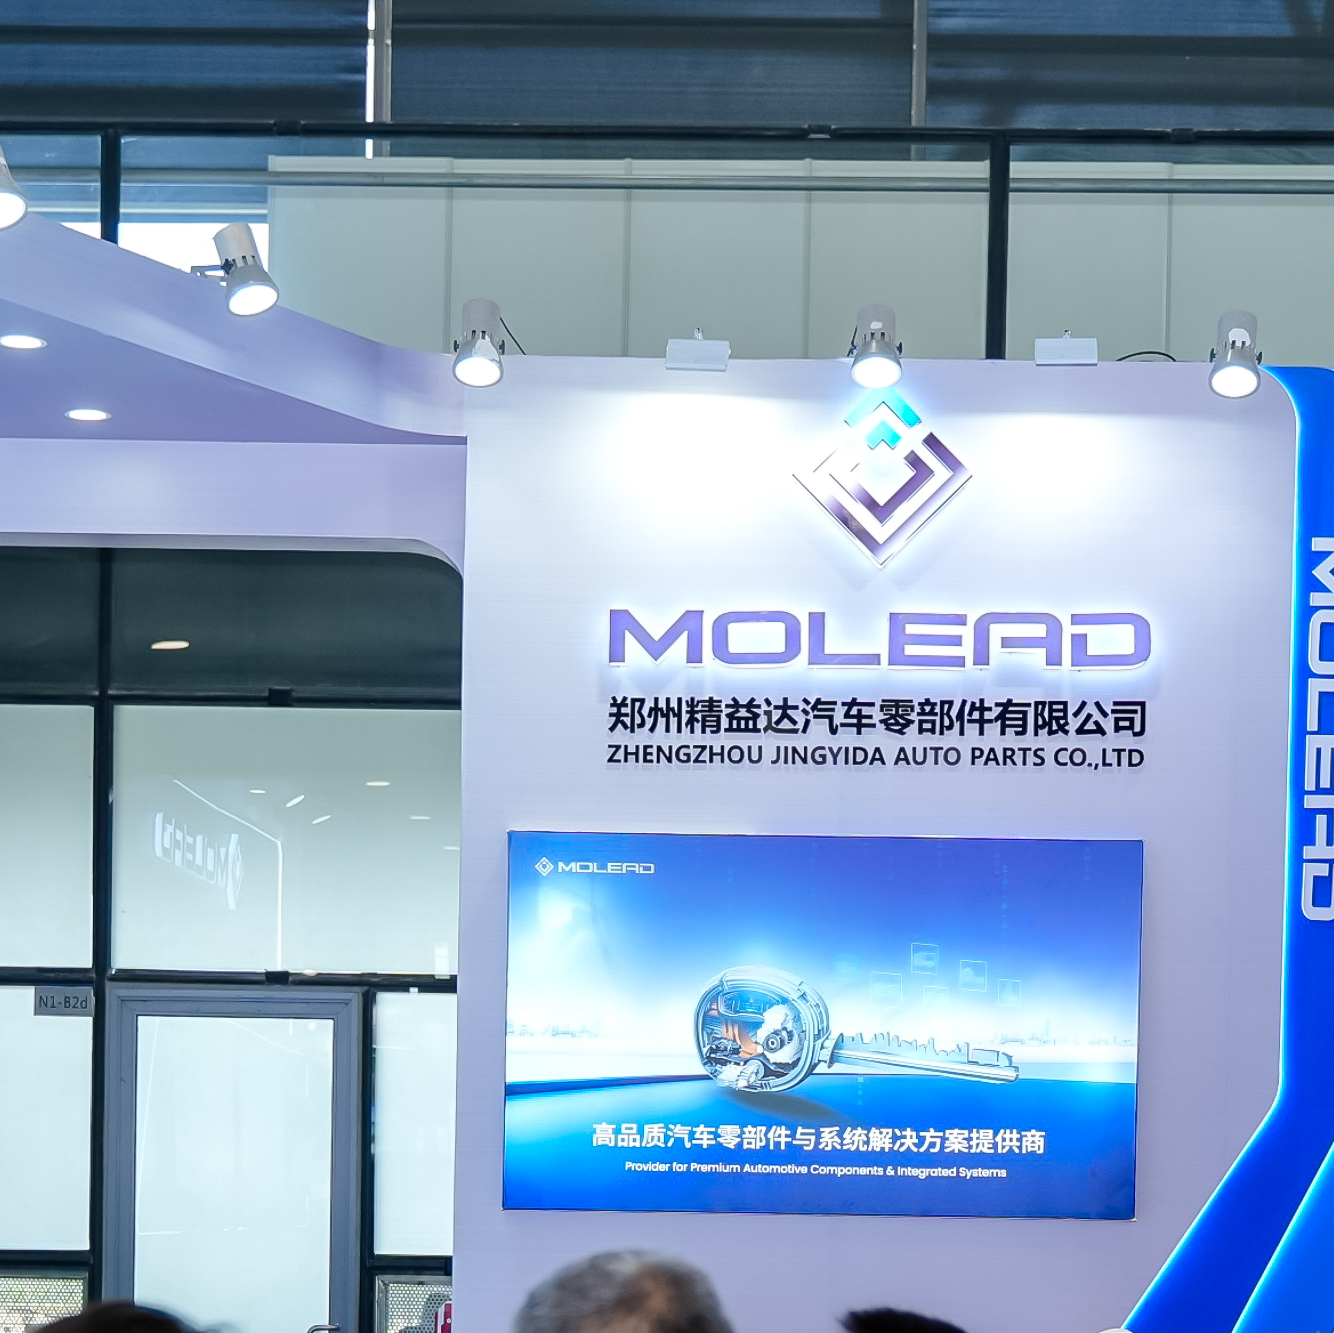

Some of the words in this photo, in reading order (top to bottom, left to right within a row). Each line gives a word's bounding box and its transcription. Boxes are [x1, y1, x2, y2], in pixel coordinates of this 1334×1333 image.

[609, 608, 1152, 671] MOLEAD
[607, 696, 1148, 738] 郑州精益达汽车零部件有限公司
[607, 744, 764, 767] ZHENGZHOU
[770, 745, 886, 767] JINGYIDA
[893, 746, 962, 767] AUTO
[971, 747, 1046, 768] PARTS
[1053, 747, 1145, 771] CO.,LTD
[557, 861, 655, 874] MOLEAD
[38, 995, 89, 1011] N1-B2d
[591, 1122, 1046, 1155] 高品质汽车零部件与系统解决方案提供商
[625, 1161, 670, 1172] Provider
[672, 1161, 688, 1172] for
[690, 1162, 741, 1173] Premium
[743, 1162, 808, 1174] Automotive
[810, 1165, 884, 1178] Components
[885, 1166, 895, 1176] &
[897, 1166, 957, 1179] Integrated
[959, 1168, 1007, 1180] Systems
